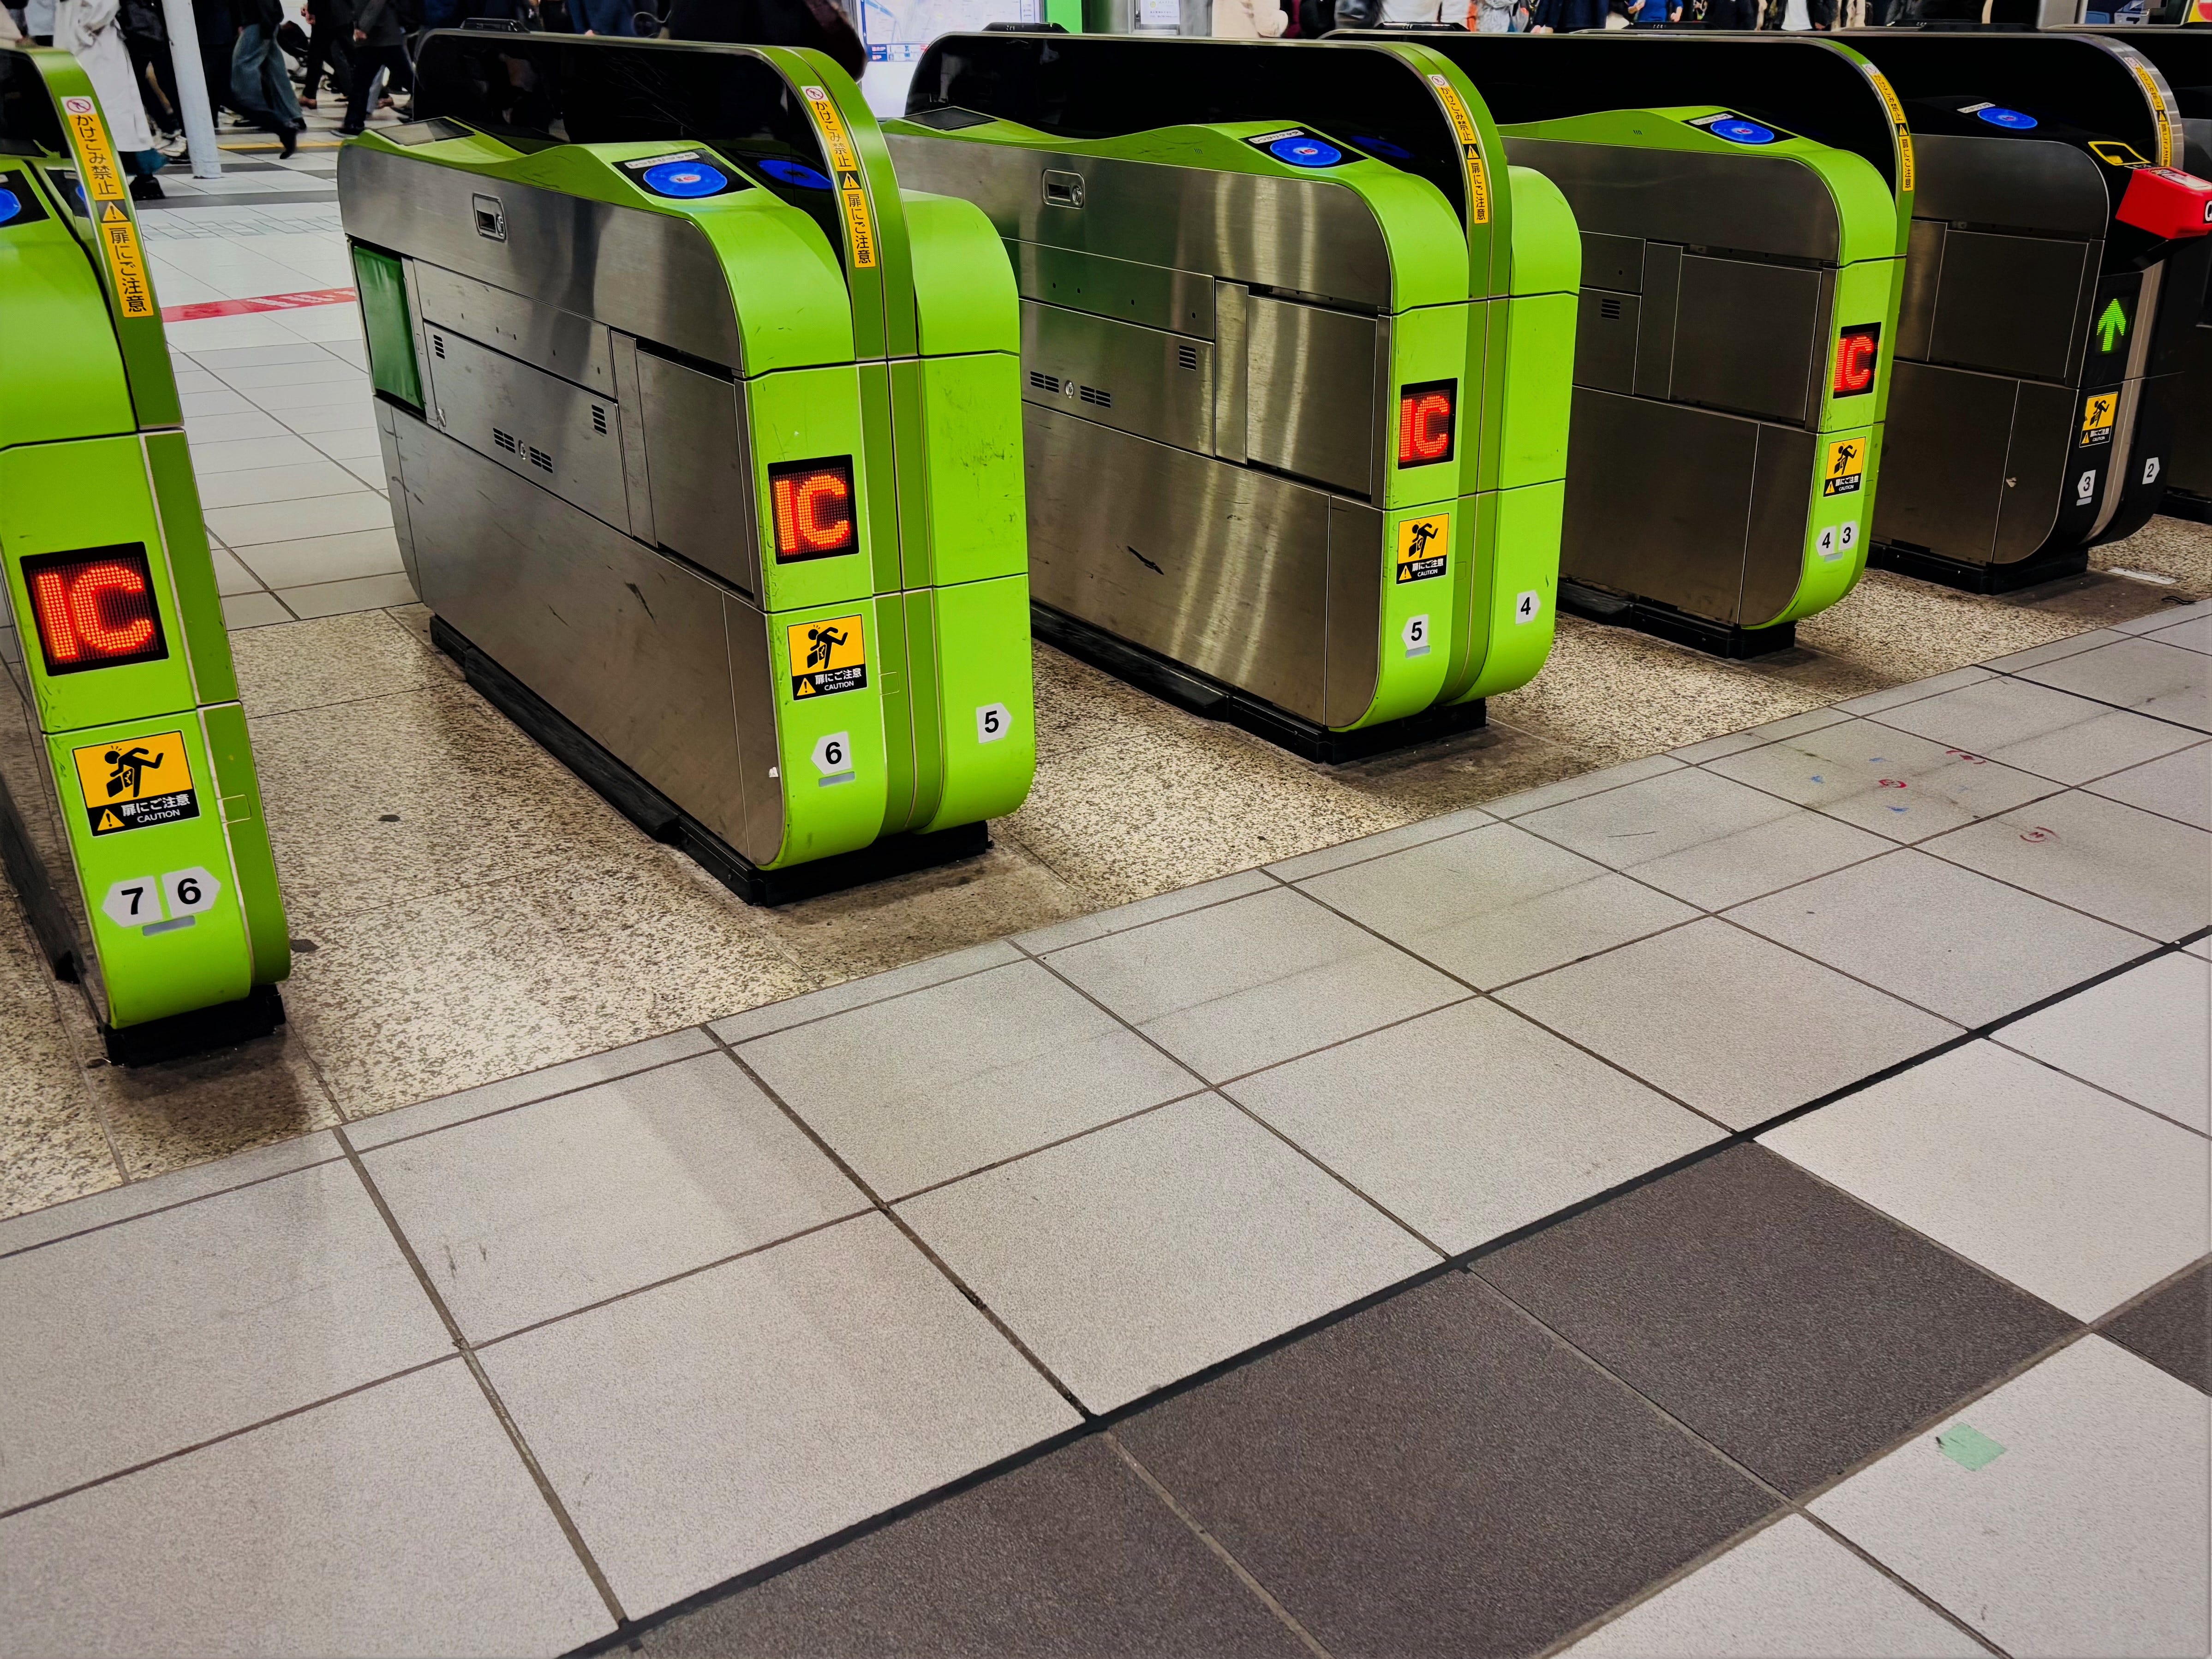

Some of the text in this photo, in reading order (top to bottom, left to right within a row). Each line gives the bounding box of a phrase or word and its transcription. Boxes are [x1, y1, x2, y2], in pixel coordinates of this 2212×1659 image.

[1441, 87, 1473, 141] かけこみ禁止
[815, 101, 852, 167] かけこみ禁止
[76, 115, 117, 195] かけこみ禁止
[1471, 163, 1485, 220] 扉にご注意
[847, 194, 872, 263] 扉にご注意
[108, 227, 147, 313] 扉にご注意
[1834, 336, 1874, 391] IC
[1399, 394, 1450, 460] IC
[2083, 476, 2091, 491] 3
[2146, 463, 2154, 478] 2
[775, 474, 849, 553] IC
[1822, 532, 1831, 549] 4
[1842, 527, 1851, 544] 3
[36, 565, 154, 660] IC
[1520, 597, 1530, 615] 4
[1411, 621, 1423, 641] 5
[815, 668, 861, 685] 扉にご注意
[824, 680, 854, 691] CAUTION
[984, 710, 999, 734] 5
[825, 741, 842, 765] 6
[121, 794, 190, 817] 扉にご注意
[137, 809, 180, 823] CAUTION
[121, 887, 144, 916] 7
[177, 877, 202, 905] 6
